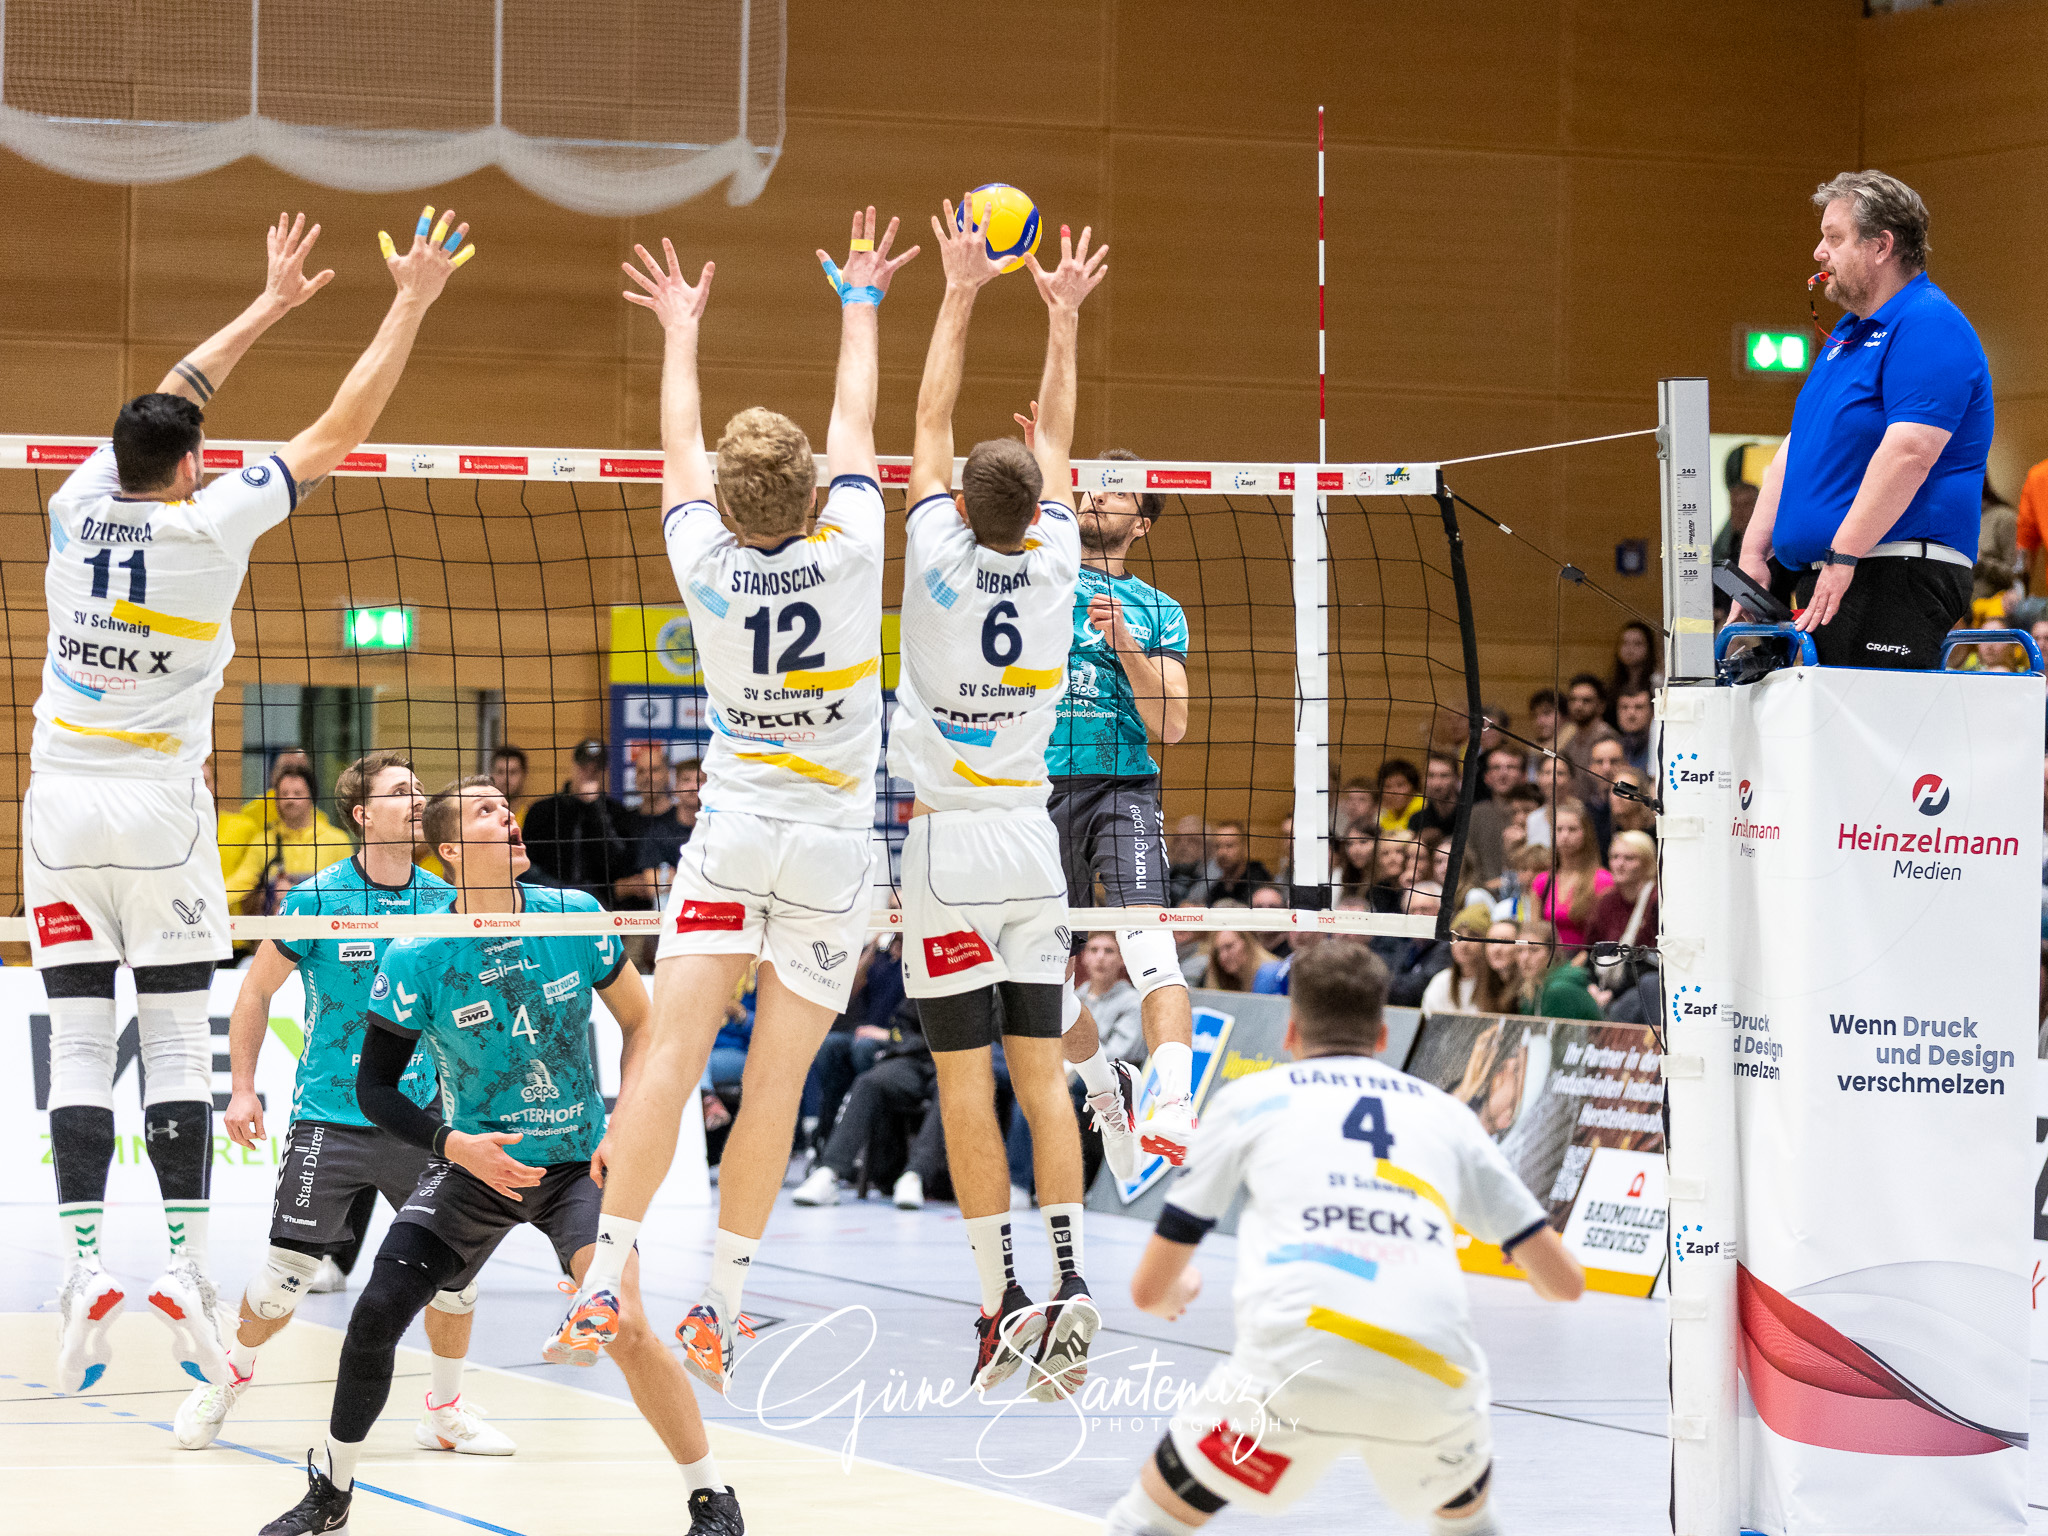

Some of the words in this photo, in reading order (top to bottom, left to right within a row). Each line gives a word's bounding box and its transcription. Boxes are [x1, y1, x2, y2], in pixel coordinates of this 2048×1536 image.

[418, 462, 435, 471] Zapf
[473, 462, 499, 471] Sparkasse
[500, 464, 524, 472] Nürnberg
[559, 466, 575, 475] Zapf
[1108, 477, 1124, 485] Zapf
[1159, 478, 1184, 486] Sparkasse
[1185, 479, 1208, 487] Nürnberg
[1241, 479, 1256, 487] Zapf
[83, 548, 147, 604] 11
[73, 610, 88, 625] SV
[91, 613, 151, 638] Schwaig
[744, 601, 826, 675] 12
[981, 600, 1023, 668] 6
[58, 634, 139, 673] SPECK
[1866, 642, 1901, 654] CRAFT
[743, 686, 760, 701] SV
[763, 684, 824, 701] Schwaig
[959, 683, 977, 697] SV
[981, 682, 1037, 698] Schwaig
[726, 706, 816, 729] SPECK
[1680, 770, 1715, 785] Zapf
[1129, 808, 1149, 889] marxgruppe
[1838, 823, 2019, 856] Heinzelmann
[1892, 859, 1962, 881] Medien
[49, 914, 83, 926] Sparkasse
[341, 921, 379, 929] Marmot
[483, 919, 521, 928] Marmot
[1168, 913, 1204, 922] Marmot
[48, 923, 82, 936] Nürnberg
[341, 949, 373, 958] SWD
[945, 941, 979, 956] Sparkasse
[947, 948, 981, 965] Nürnberg
[789, 959, 842, 991] OFFICEWELT
[458, 1009, 489, 1026] SWD
[1684, 1002, 1717, 1018] Zapf
[511, 1004, 540, 1045] 4
[1733, 1011, 1770, 1032] Druck
[1829, 1013, 1897, 1037] Wenn
[1902, 1015, 1979, 1039] Druck
[1744, 1037, 1783, 1064] Design
[1876, 1043, 1921, 1066] und
[1927, 1043, 2015, 1074] Design
[1836, 1071, 2005, 1095] verschmelzen
[521, 1084, 561, 1103] gepe
[1340, 1095, 1397, 1160] 4
[294, 1127, 325, 1168] Düren
[295, 1170, 315, 1208] Stadt
[1302, 1205, 1413, 1239] SPECK
[1583, 1226, 1651, 1254] SERVICES
[1686, 1242, 1720, 1257] Zapf
